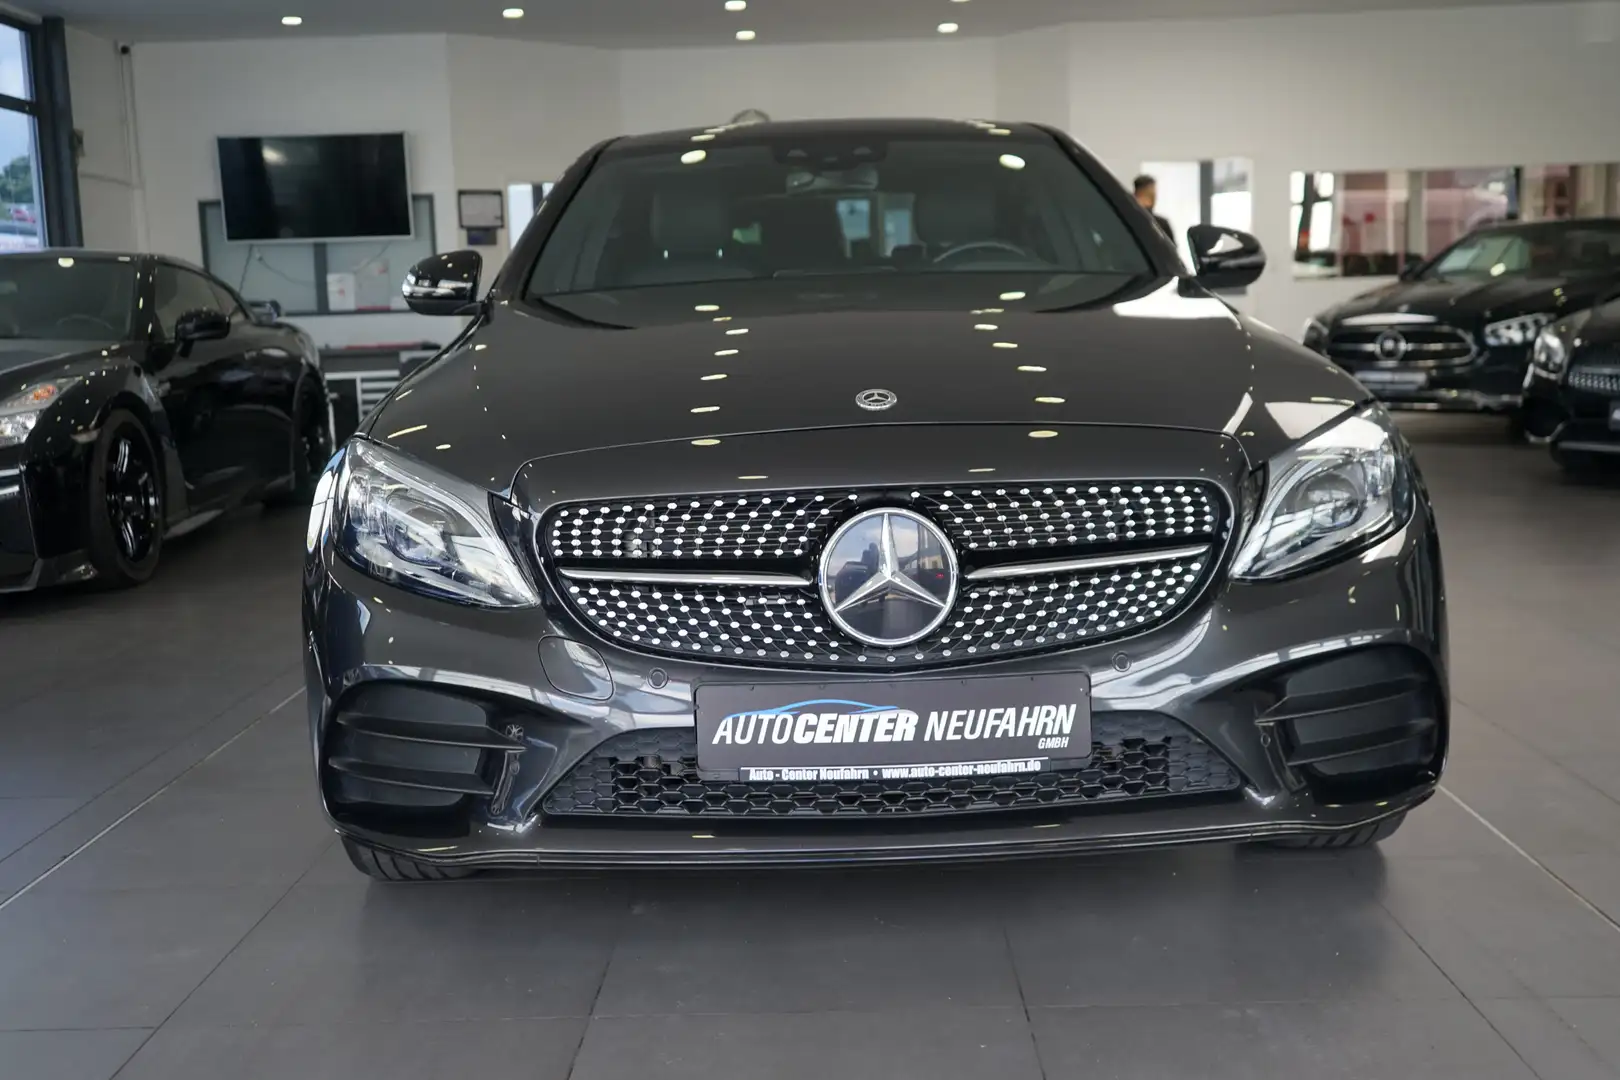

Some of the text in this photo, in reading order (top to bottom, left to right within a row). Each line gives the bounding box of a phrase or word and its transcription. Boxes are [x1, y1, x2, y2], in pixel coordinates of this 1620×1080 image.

[711, 704, 1077, 745] AUTOCENTER NEUFAHRN
[1037, 736, 1069, 750] GMBH
[749, 768, 774, 780] Auto
[781, 768, 818, 780] Center
[819, 767, 870, 780] Neufahrn
[881, 759, 1042, 779] www.auto-center-neufahrn.de
